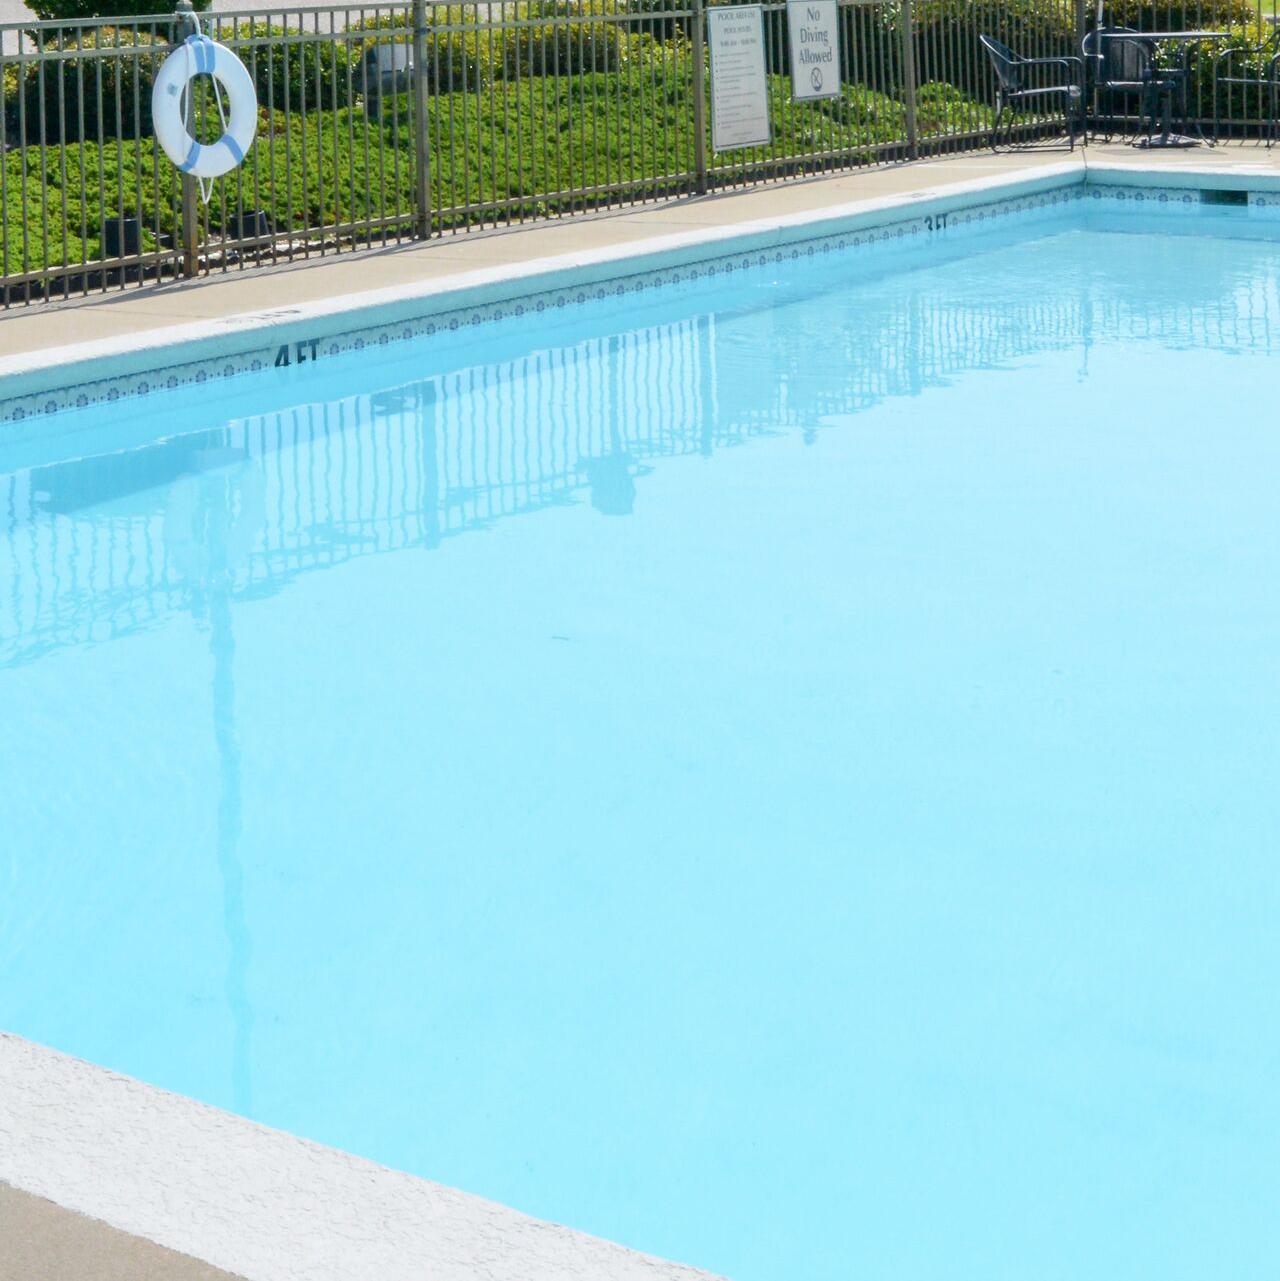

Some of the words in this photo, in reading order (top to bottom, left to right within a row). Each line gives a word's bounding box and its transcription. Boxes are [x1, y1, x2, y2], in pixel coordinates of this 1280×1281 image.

[718, 12, 734, 21] POOL
[807, 6, 821, 22] No
[800, 27, 829, 46] Diving
[799, 47, 833, 64] Allowed
[275, 344, 292, 368] 4
[295, 337, 321, 365] FT
